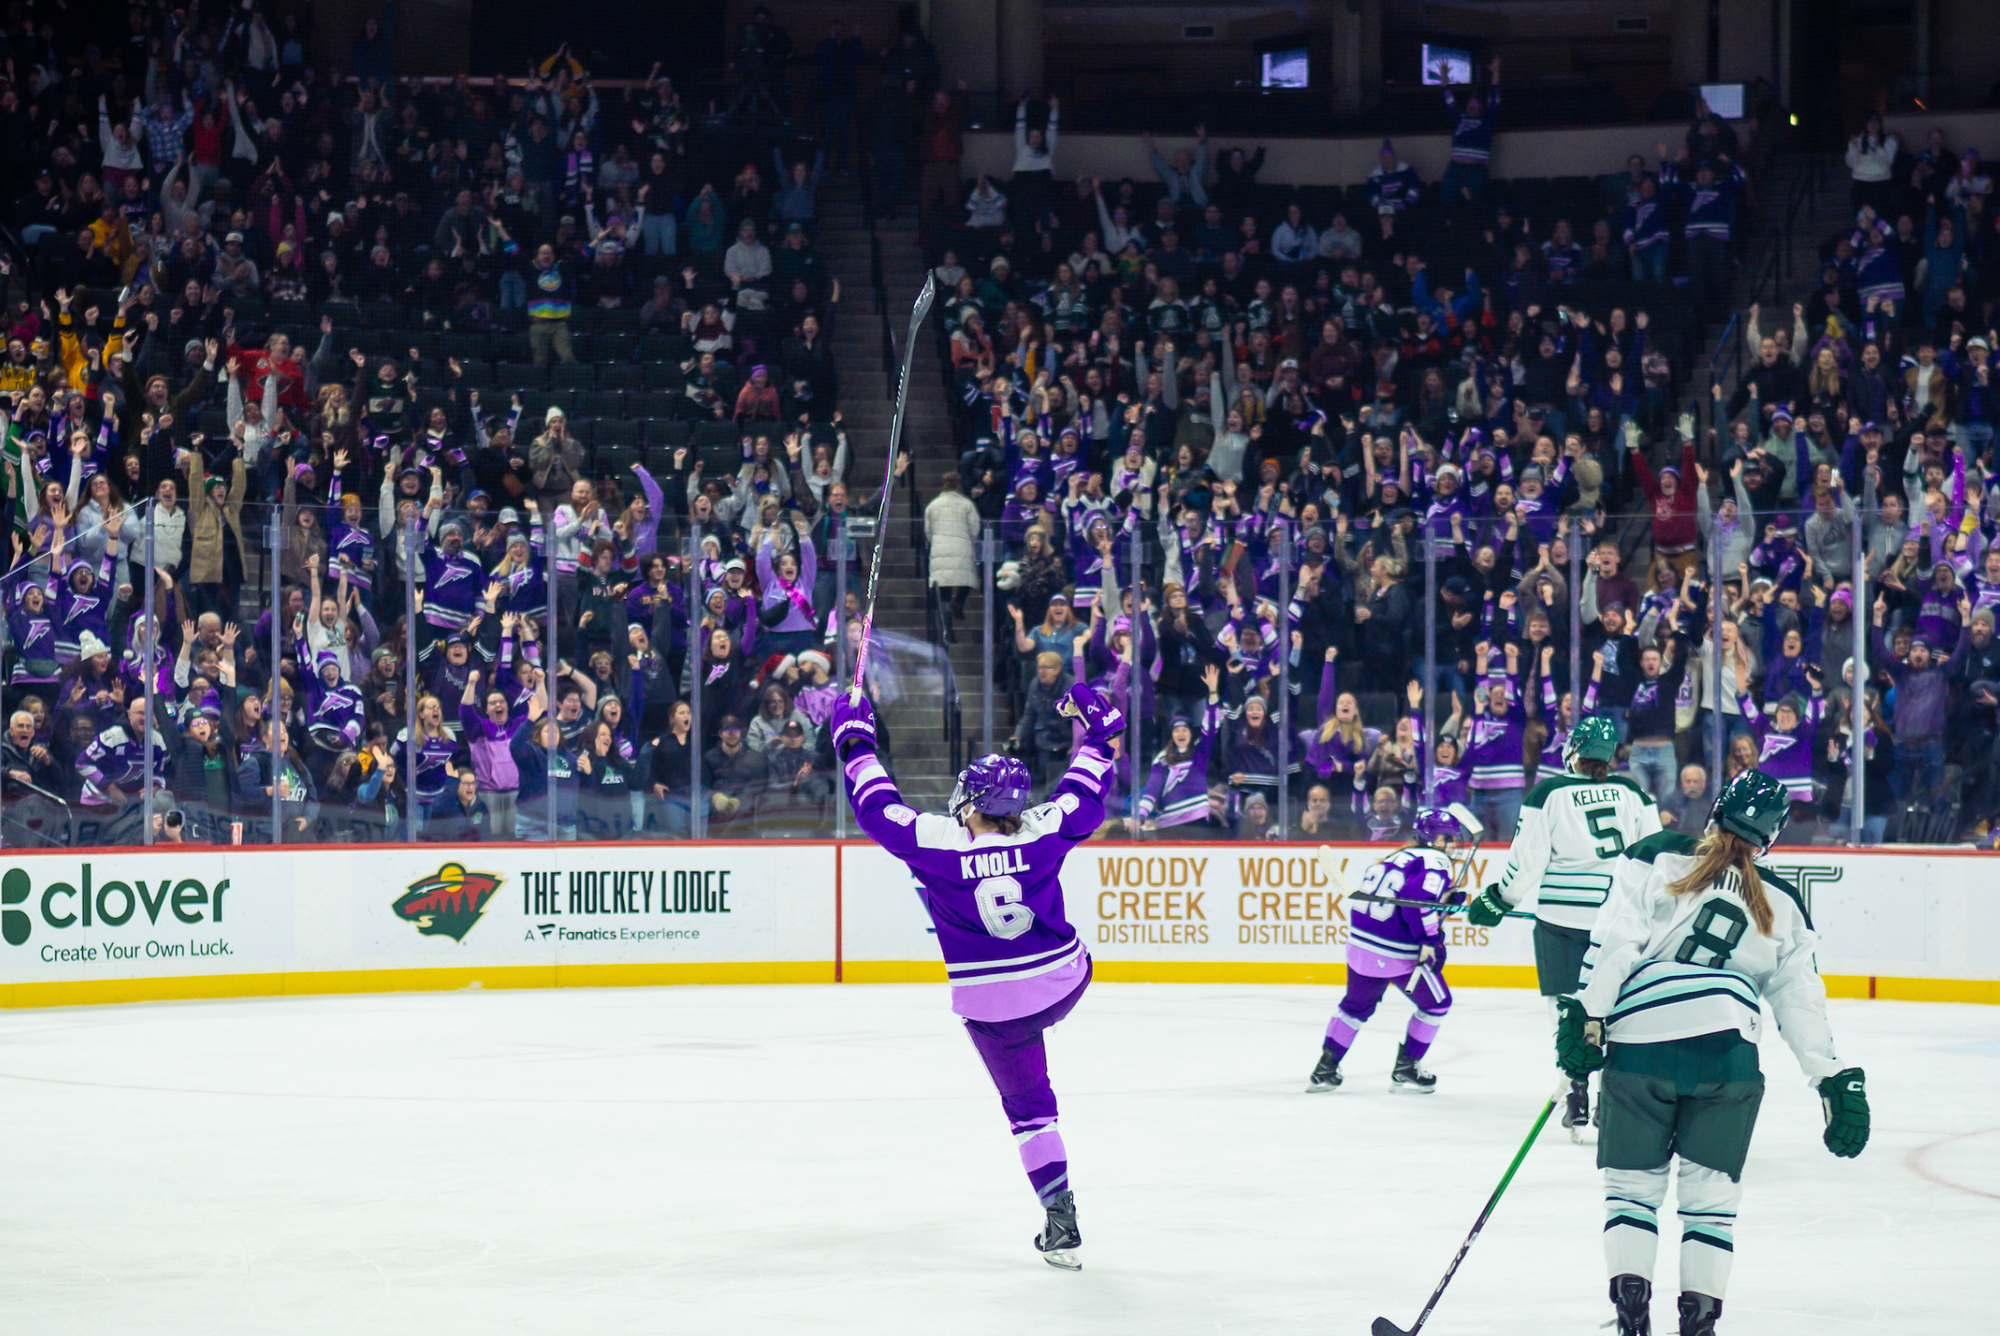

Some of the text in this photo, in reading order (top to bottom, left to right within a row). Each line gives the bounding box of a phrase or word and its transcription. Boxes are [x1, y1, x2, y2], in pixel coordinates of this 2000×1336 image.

[1571, 789, 1621, 807] KELLER
[1585, 806, 1626, 860] 5
[960, 848, 1031, 880] KNOLL
[1097, 857, 1209, 887] WOODY
[41, 863, 230, 929] clover
[520, 870, 731, 915] THE HOCKEY LODGE
[1353, 864, 1406, 922] 26
[1711, 868, 1748, 903] WIN
[973, 875, 1036, 941] 6
[1097, 891, 1207, 920] CREEK
[1238, 891, 1347, 921] CREEK
[524, 927, 700, 942] A Fanatics Experience
[1097, 924, 1209, 944] DISTILLERS
[1238, 924, 1349, 945] DISTILLERS
[1674, 897, 1749, 970] 8
[40, 938, 234, 963] Create Your Own Luck.
